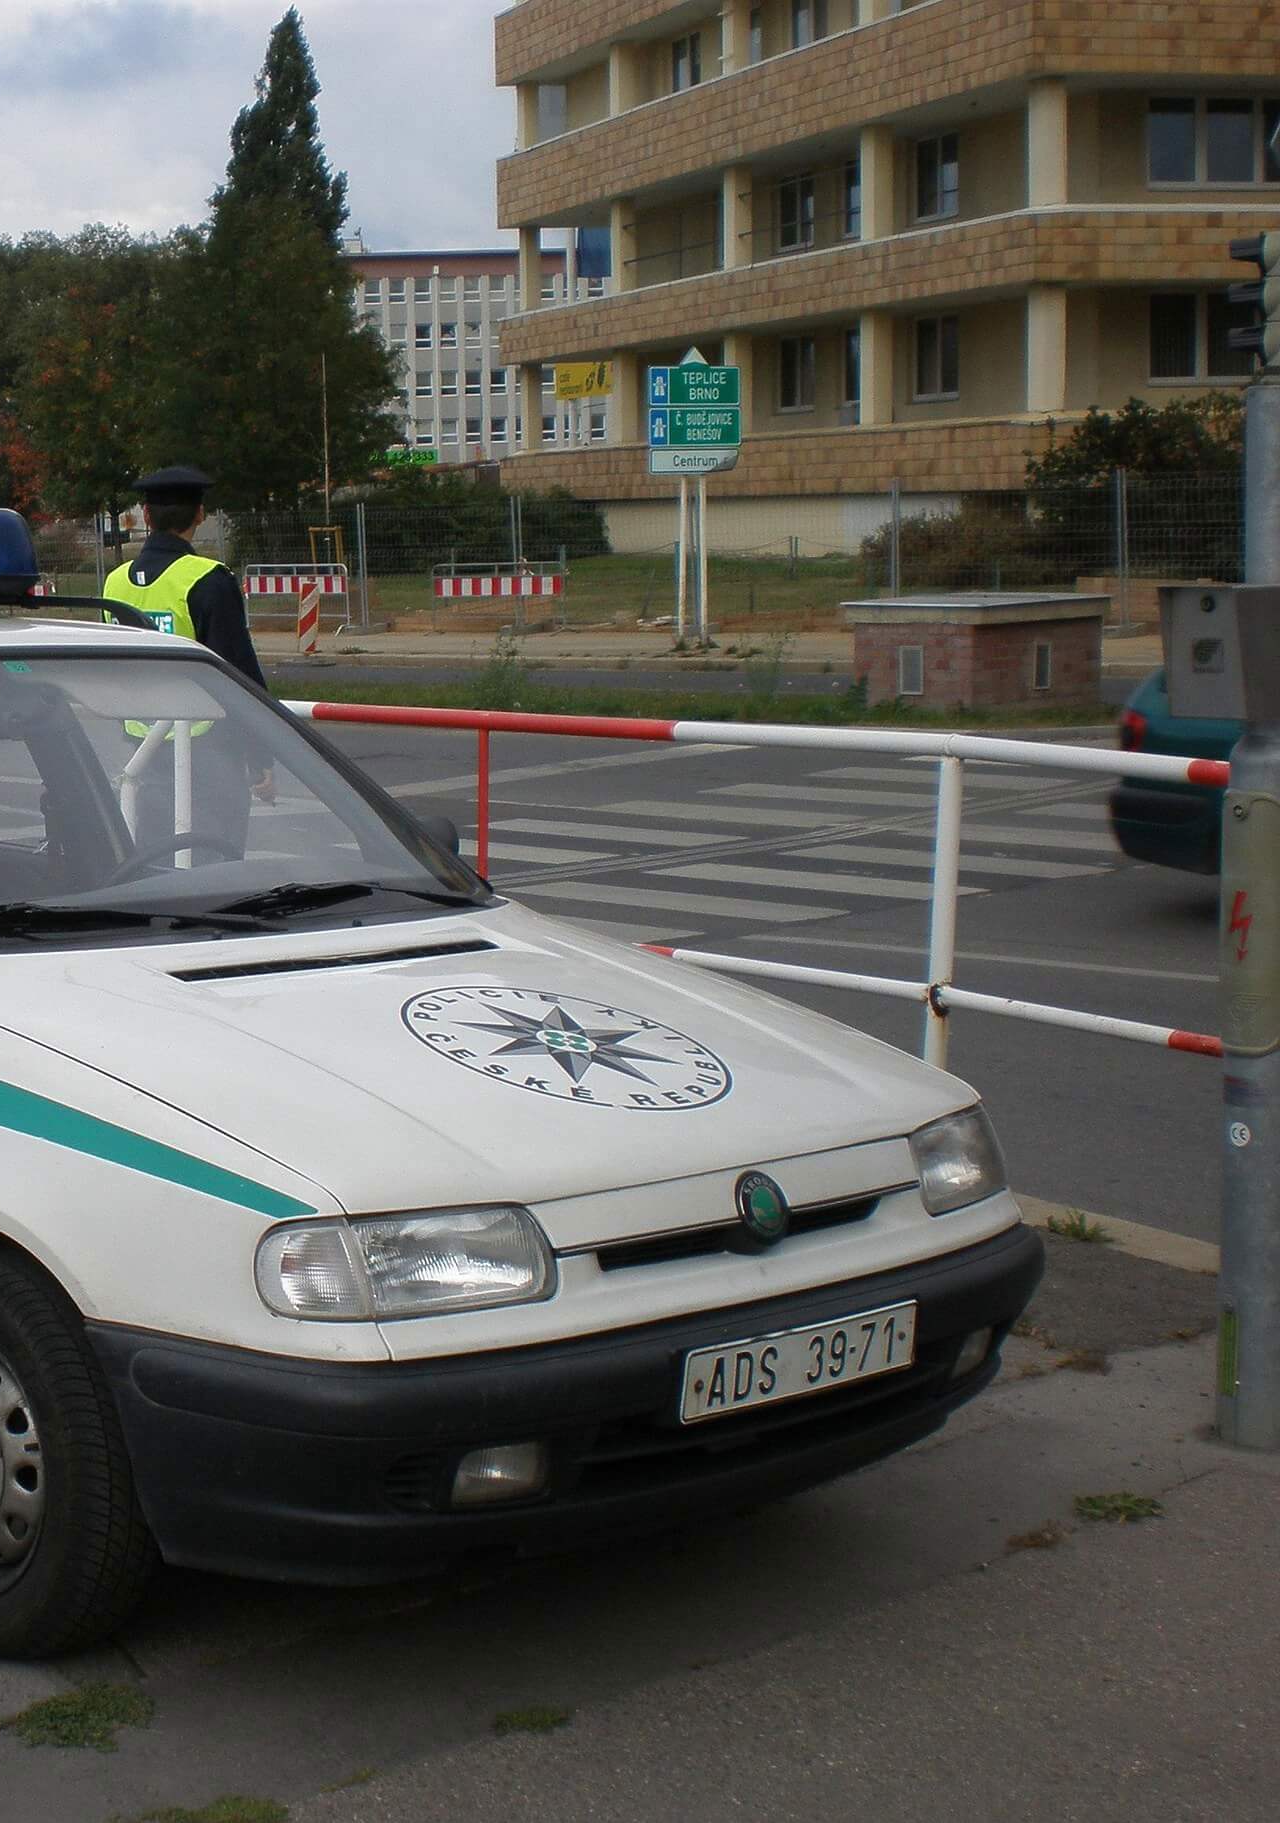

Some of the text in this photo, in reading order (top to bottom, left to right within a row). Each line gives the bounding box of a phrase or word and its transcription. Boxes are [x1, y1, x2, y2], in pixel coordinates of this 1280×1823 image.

[682, 371, 727, 385] TEPLICE
[689, 388, 720, 401] BRNO
[686, 411, 733, 426] BUDĚJOVICE
[686, 425, 722, 441] BENEŠOV
[672, 454, 720, 468] Centrum
[413, 988, 561, 1022] POLICIE
[424, 1030, 596, 1101] ČESKÉ
[706, 1315, 895, 1408] ADS 39-71
